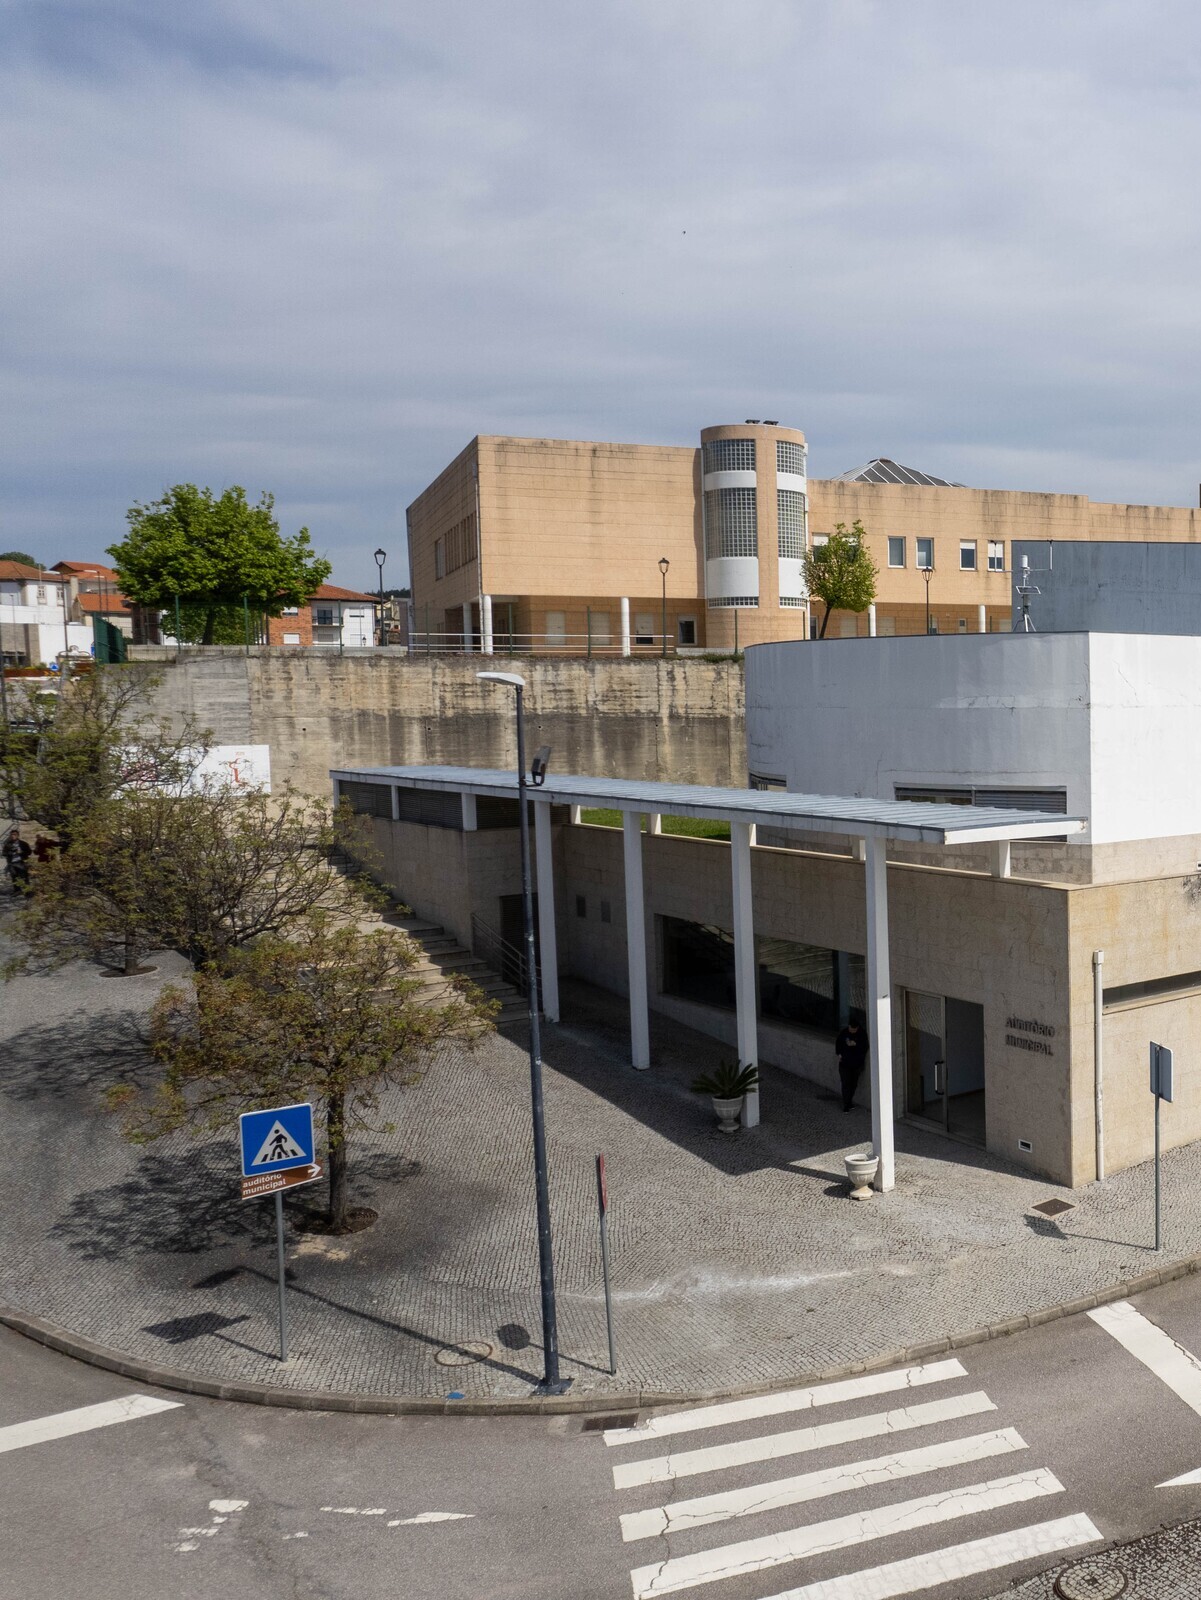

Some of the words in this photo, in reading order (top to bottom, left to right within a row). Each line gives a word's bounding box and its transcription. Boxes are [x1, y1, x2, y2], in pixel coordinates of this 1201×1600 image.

[1005, 1016, 1056, 1038] AUDITÓRIO
[1005, 1034, 1054, 1056] MUNICIPAL
[242, 1173, 282, 1188] auditório
[242, 1178, 287, 1195] municipal
